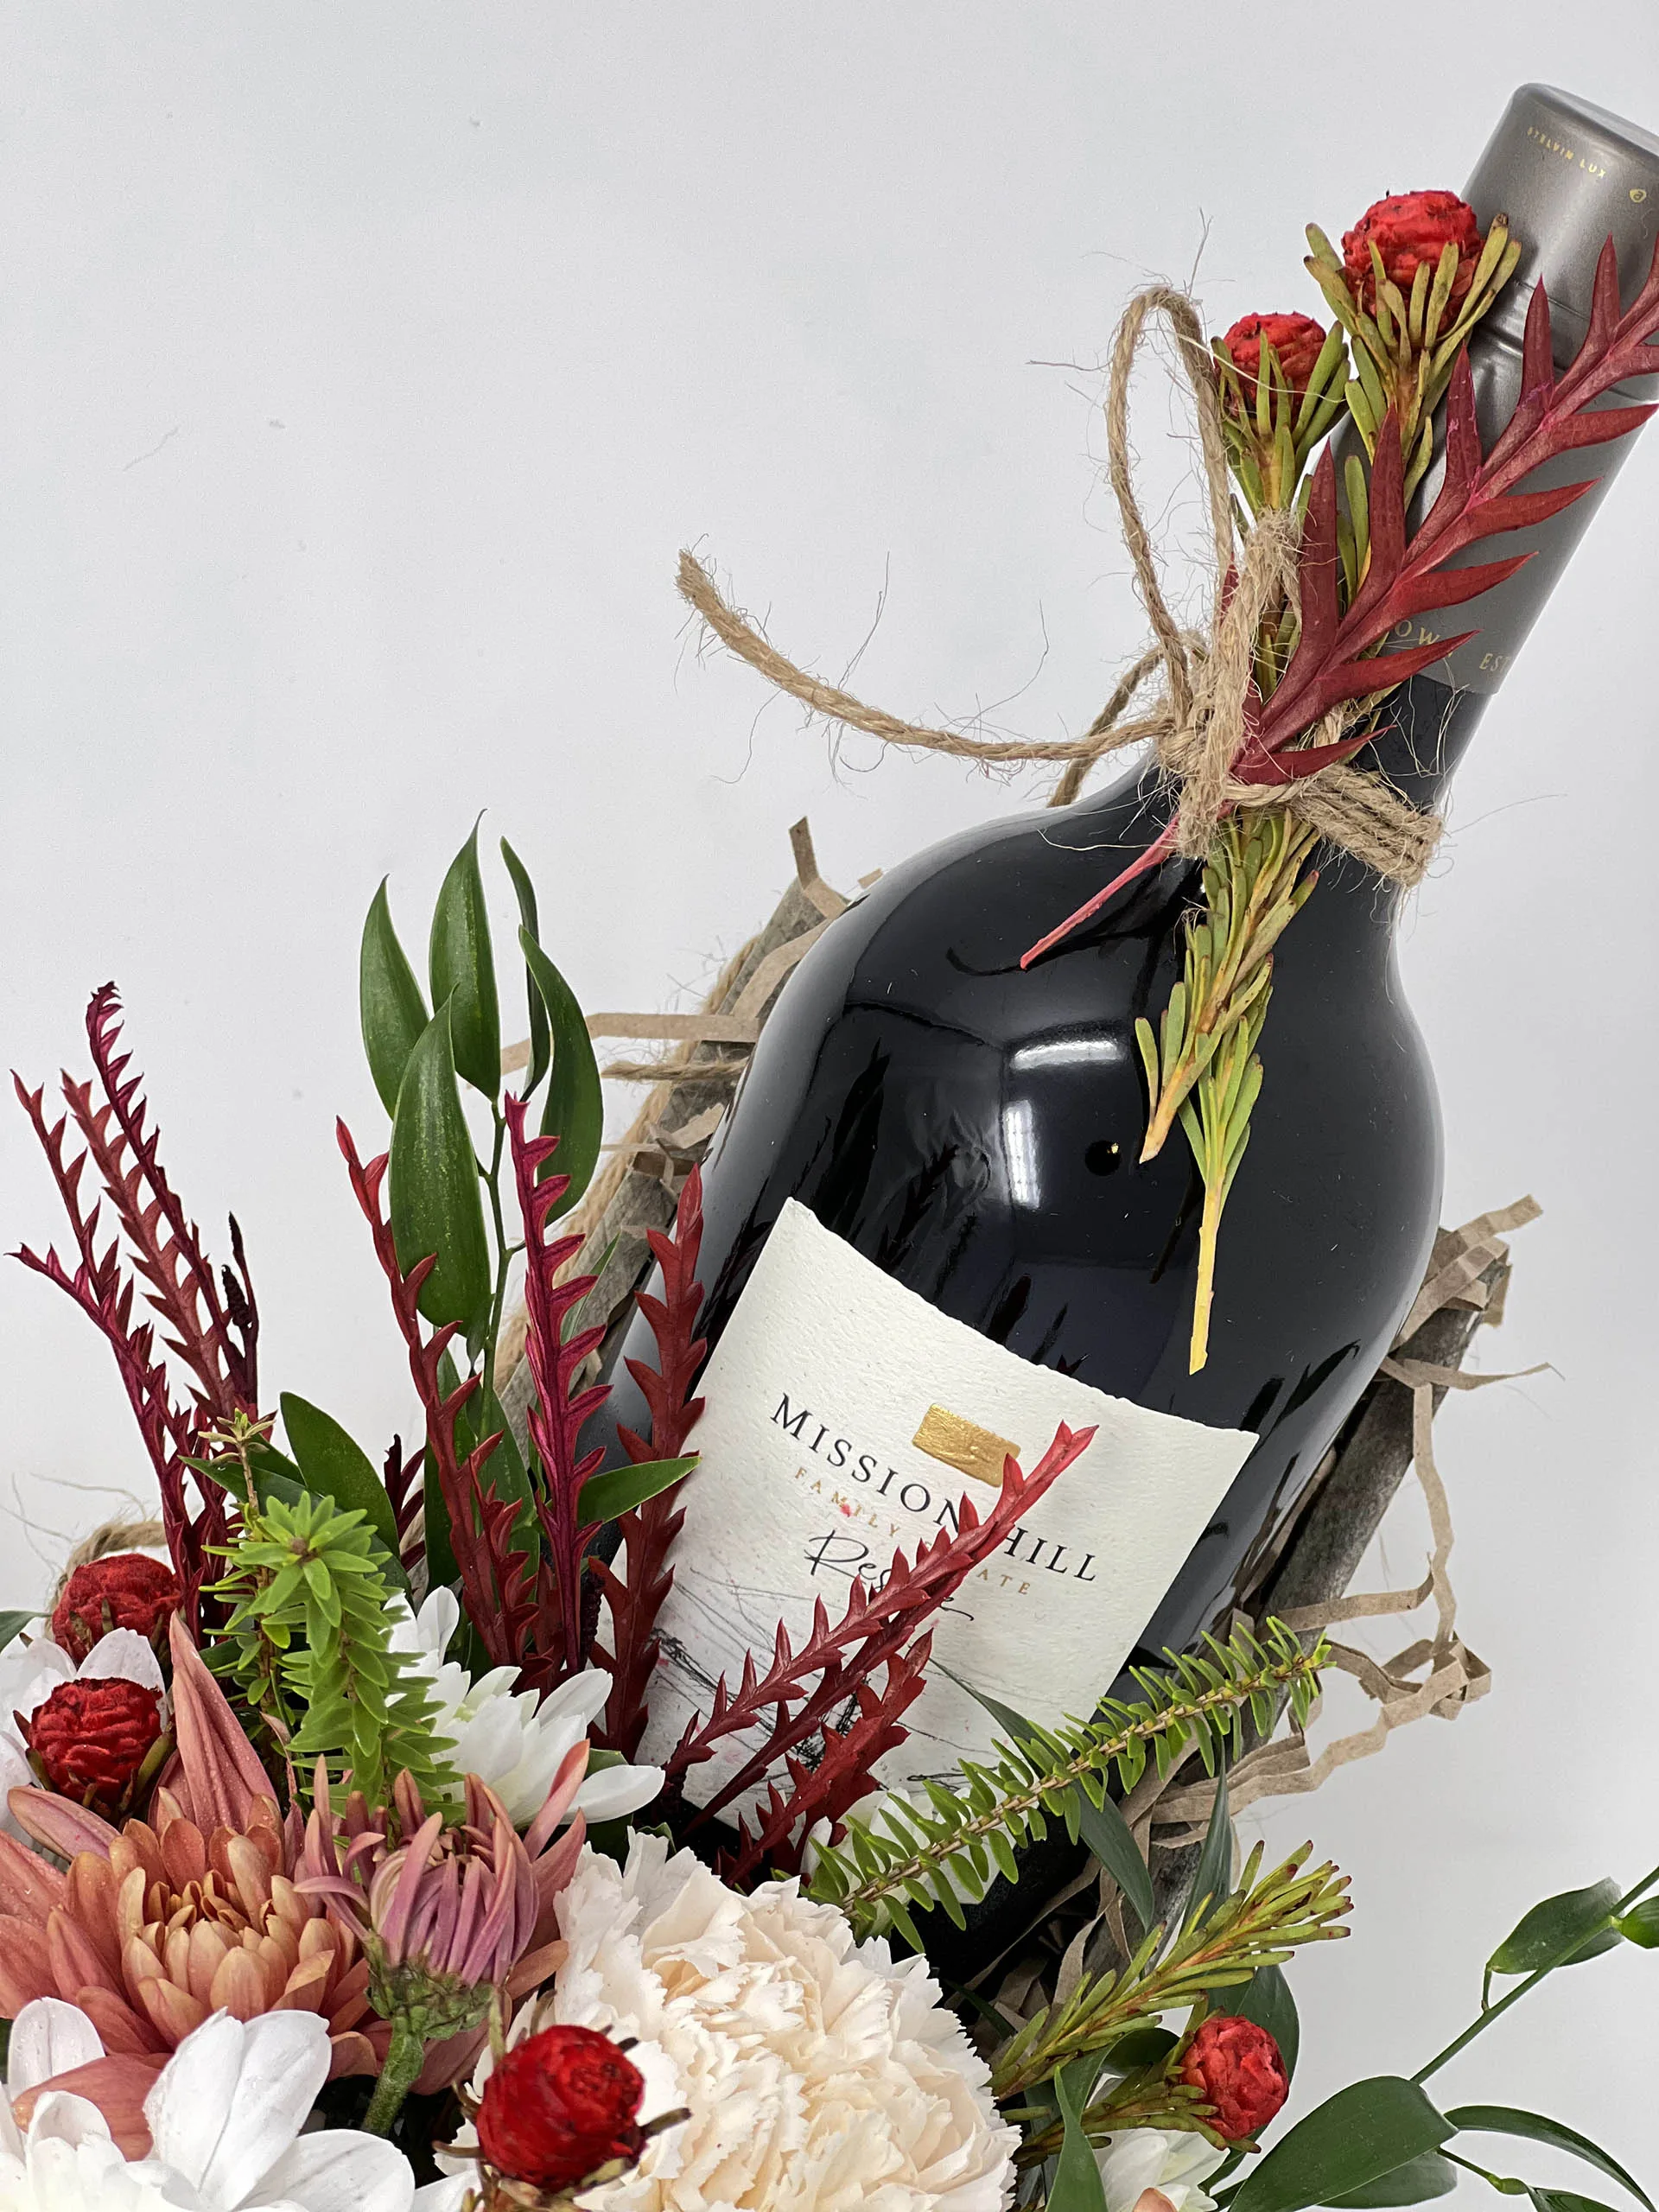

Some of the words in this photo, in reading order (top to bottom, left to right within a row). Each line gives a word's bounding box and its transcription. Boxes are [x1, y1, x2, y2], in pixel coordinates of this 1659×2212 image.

[1580, 158, 1606, 179] LUX
[770, 1392, 959, 1535] MISSION
[1003, 1527, 1096, 1582] HILL
[794, 1466, 900, 1538] FAMILY
